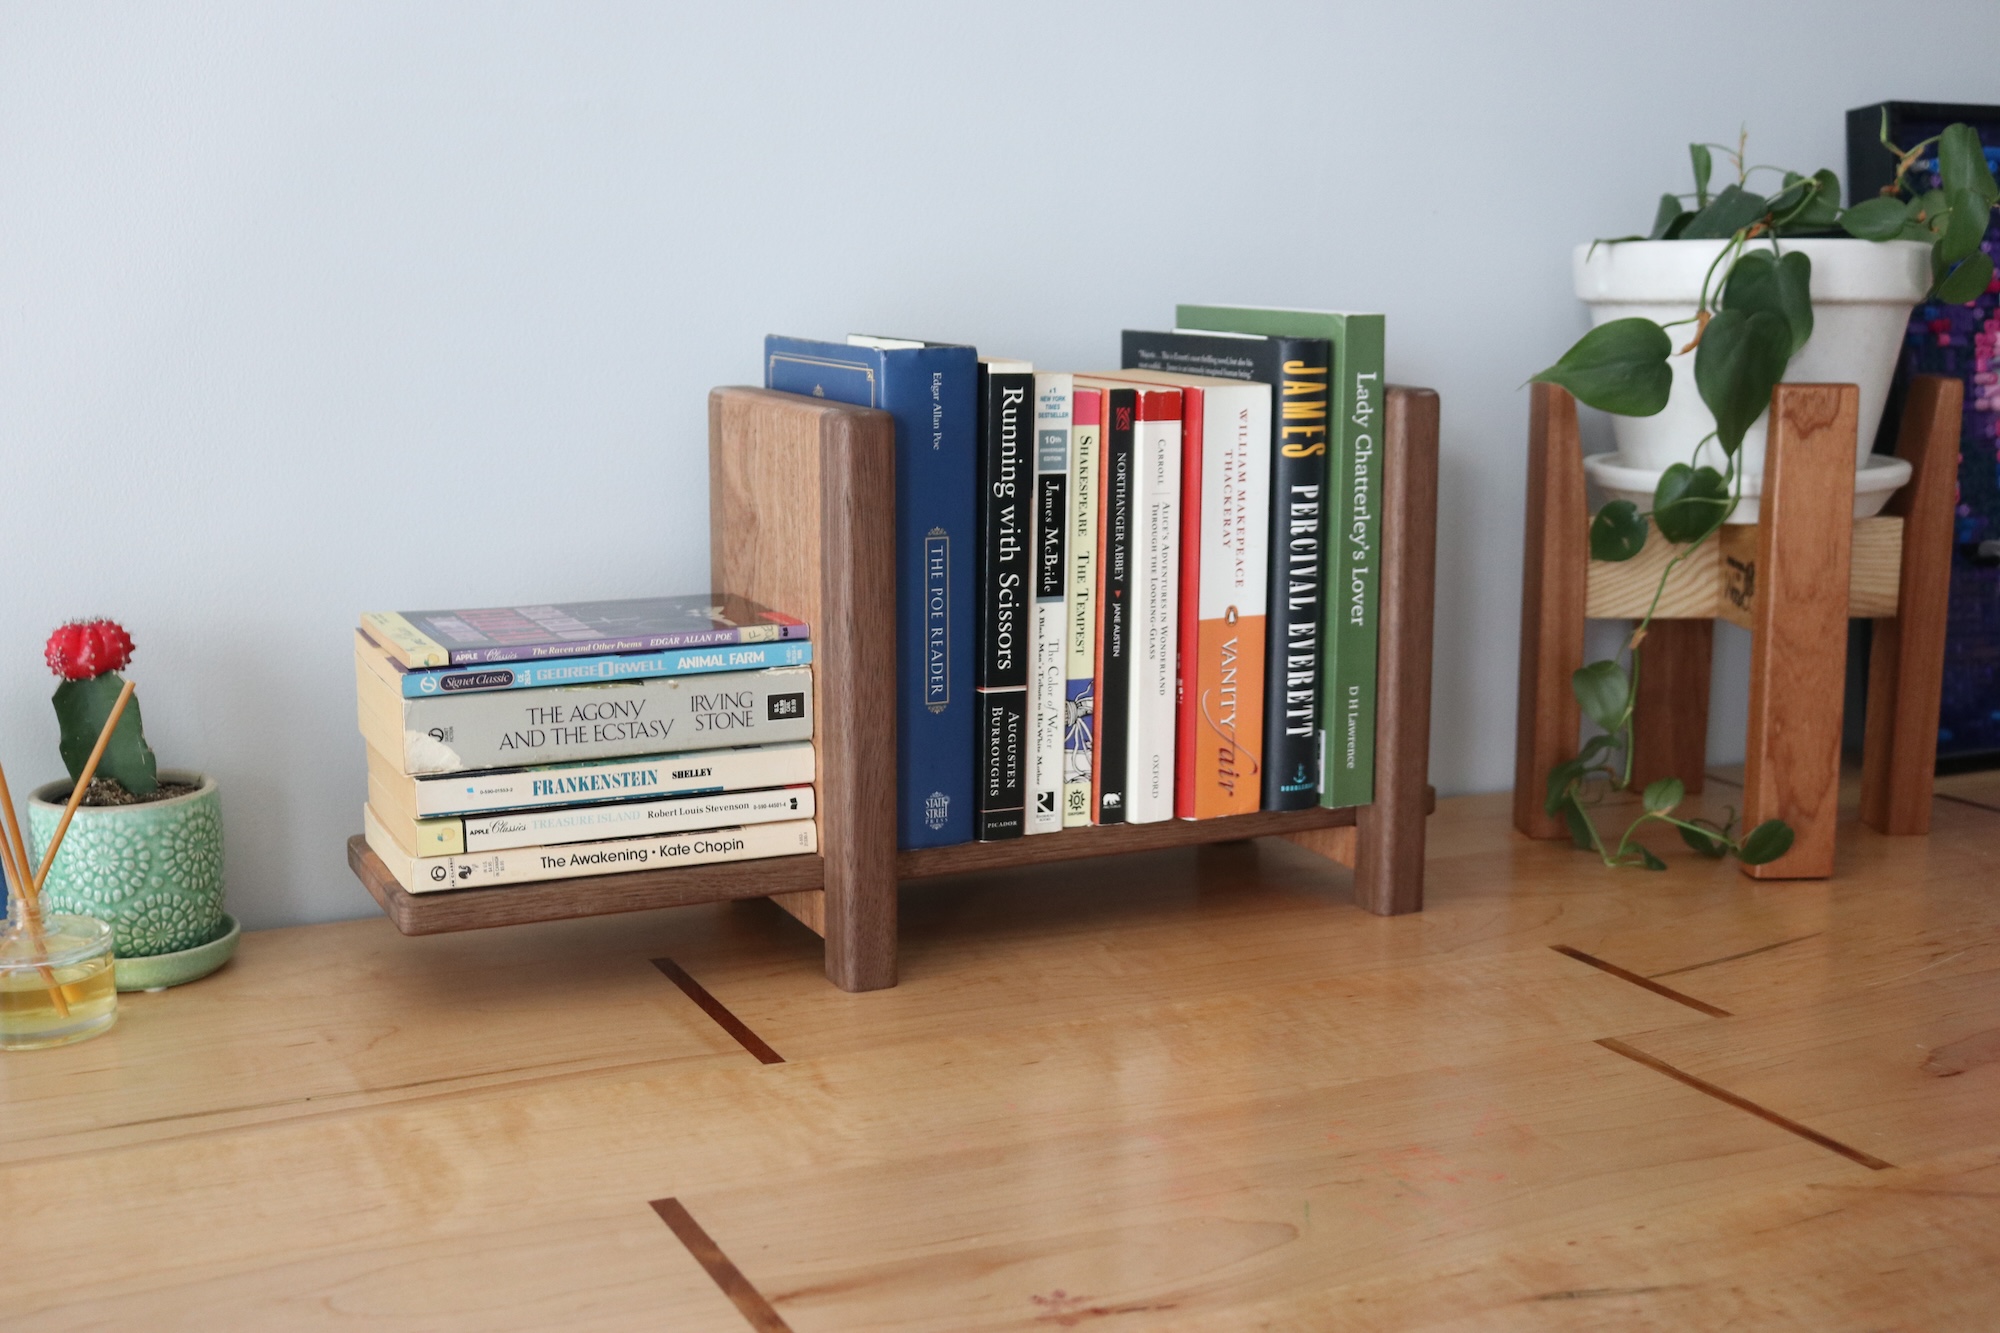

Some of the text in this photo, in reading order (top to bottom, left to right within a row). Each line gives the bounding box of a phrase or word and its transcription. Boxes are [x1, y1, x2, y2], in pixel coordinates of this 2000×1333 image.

[930, 372, 942, 450] Edgar Allan Poe
[1281, 360, 1328, 458] JAMES
[1045, 436, 1061, 444] 10th
[1157, 440, 1166, 485] CARROLL
[1114, 452, 1126, 582] NORTHANGER ABBEY
[1222, 449, 1233, 549] THACKERAY
[1234, 408, 1248, 588] WILLIAM MAKEPEACE
[1349, 372, 1377, 626] Lady Chatterley's Lover
[993, 386, 1024, 670] Running with Scissors
[1044, 481, 1059, 592] James McBride
[1075, 436, 1092, 656] SHAKESPEARE THE TEMPEST
[1151, 503, 1160, 553] THROUGH
[930, 545, 944, 696] THE POE READER
[1149, 578, 1158, 660] LOOKING-GLASS
[1159, 502, 1170, 696] ALICE'S ADVENTURES IN WONDERLAND
[1286, 484, 1320, 738] PERCIVAL EVERETT
[532, 640, 642, 656] The Raven and Other Poems
[650, 632, 732, 646] EDGAR ALLAN POE
[1112, 603, 1121, 656] JANE AUSTEN
[455, 649, 518, 662] APPLE Classics
[536, 660, 666, 680] GEORGE ORWELL
[677, 650, 765, 670] ANIMAL FARM
[446, 674, 510, 689] Signet Classic
[691, 691, 754, 713] IRVING
[1044, 638, 1060, 749] The Color of Water
[526, 699, 646, 725] THE AGONY
[696, 711, 754, 732] STONE
[1038, 702, 1044, 710] to
[1202, 636, 1258, 797] VANITY fair
[1346, 686, 1359, 768] D H Lawrence
[499, 719, 674, 750] AND THE ECSTASY
[990, 706, 1003, 796] BURROUGHS
[1006, 712, 1020, 788] AUGUSTEN
[533, 770, 658, 796] FRANKENSTEIN
[672, 768, 712, 779] SHELLEY
[1152, 755, 1160, 798] OXFORD
[532, 811, 640, 830] TREASURE ISLAND
[648, 802, 749, 819] Robert Louis Stevenson
[925, 798, 944, 808] STATE
[925, 808, 948, 819] STREET
[490, 820, 527, 834] Classics
[541, 838, 744, 869] The Awakening Kate Chopin
